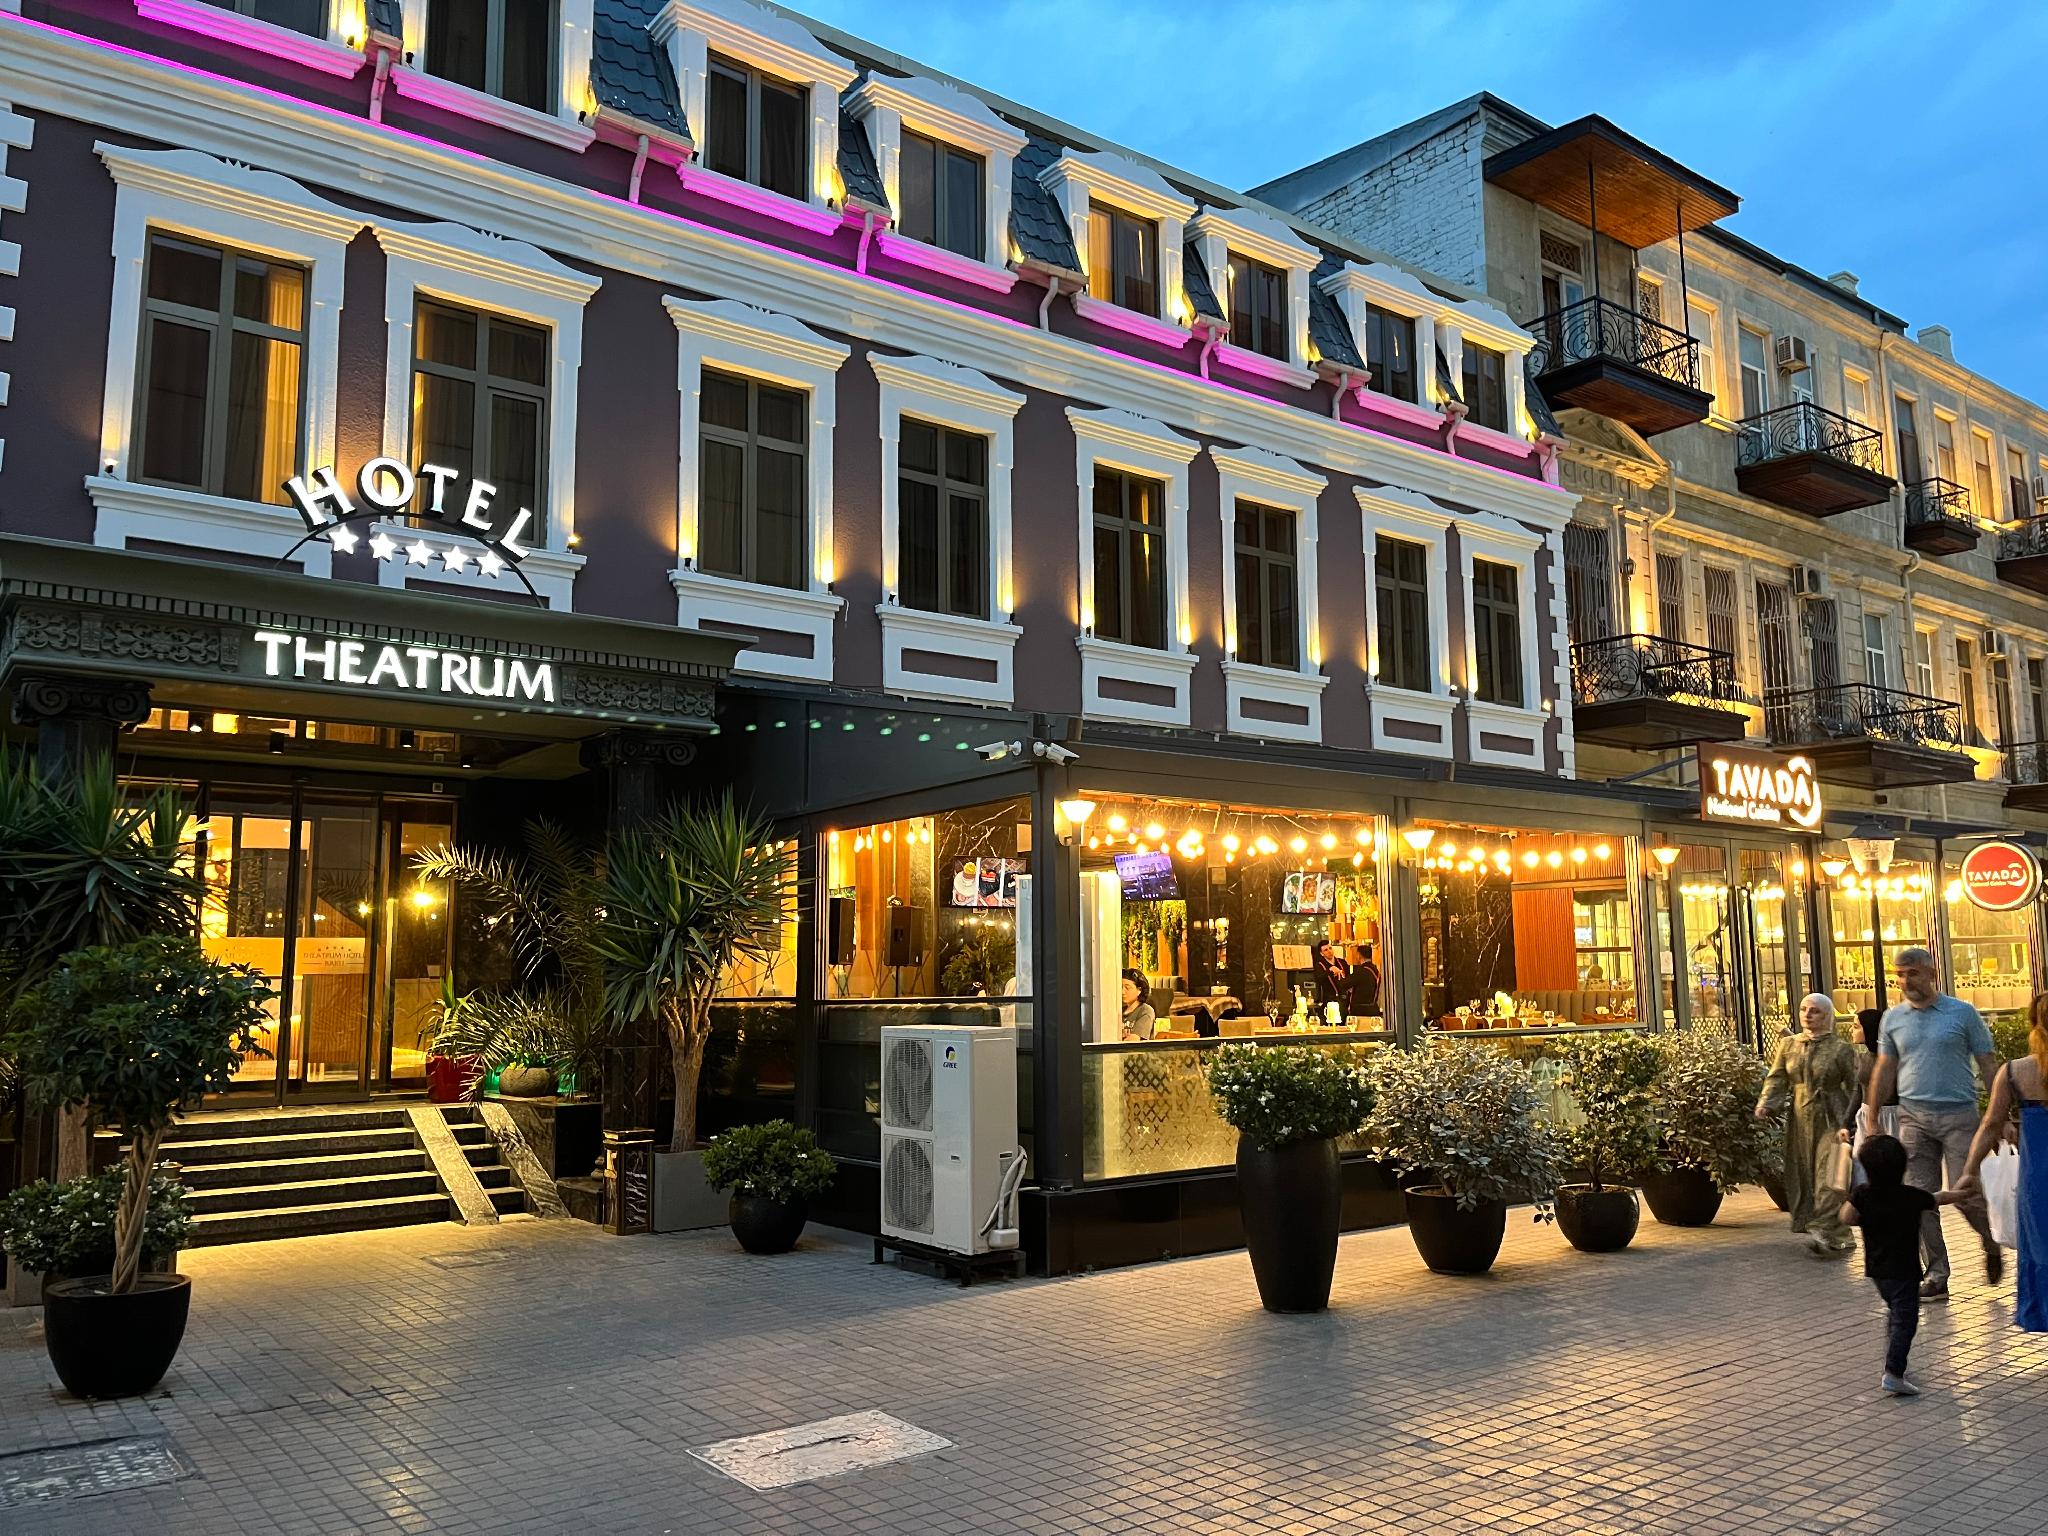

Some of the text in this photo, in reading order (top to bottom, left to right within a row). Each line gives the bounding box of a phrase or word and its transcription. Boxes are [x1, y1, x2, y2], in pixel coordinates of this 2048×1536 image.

[282, 457, 532, 562] HOTEL
[254, 631, 555, 702] THEATRUM
[1712, 758, 1812, 806] TAVADA
[1967, 869, 2021, 881] TAVADA
[942, 1061, 958, 1069] GREE
